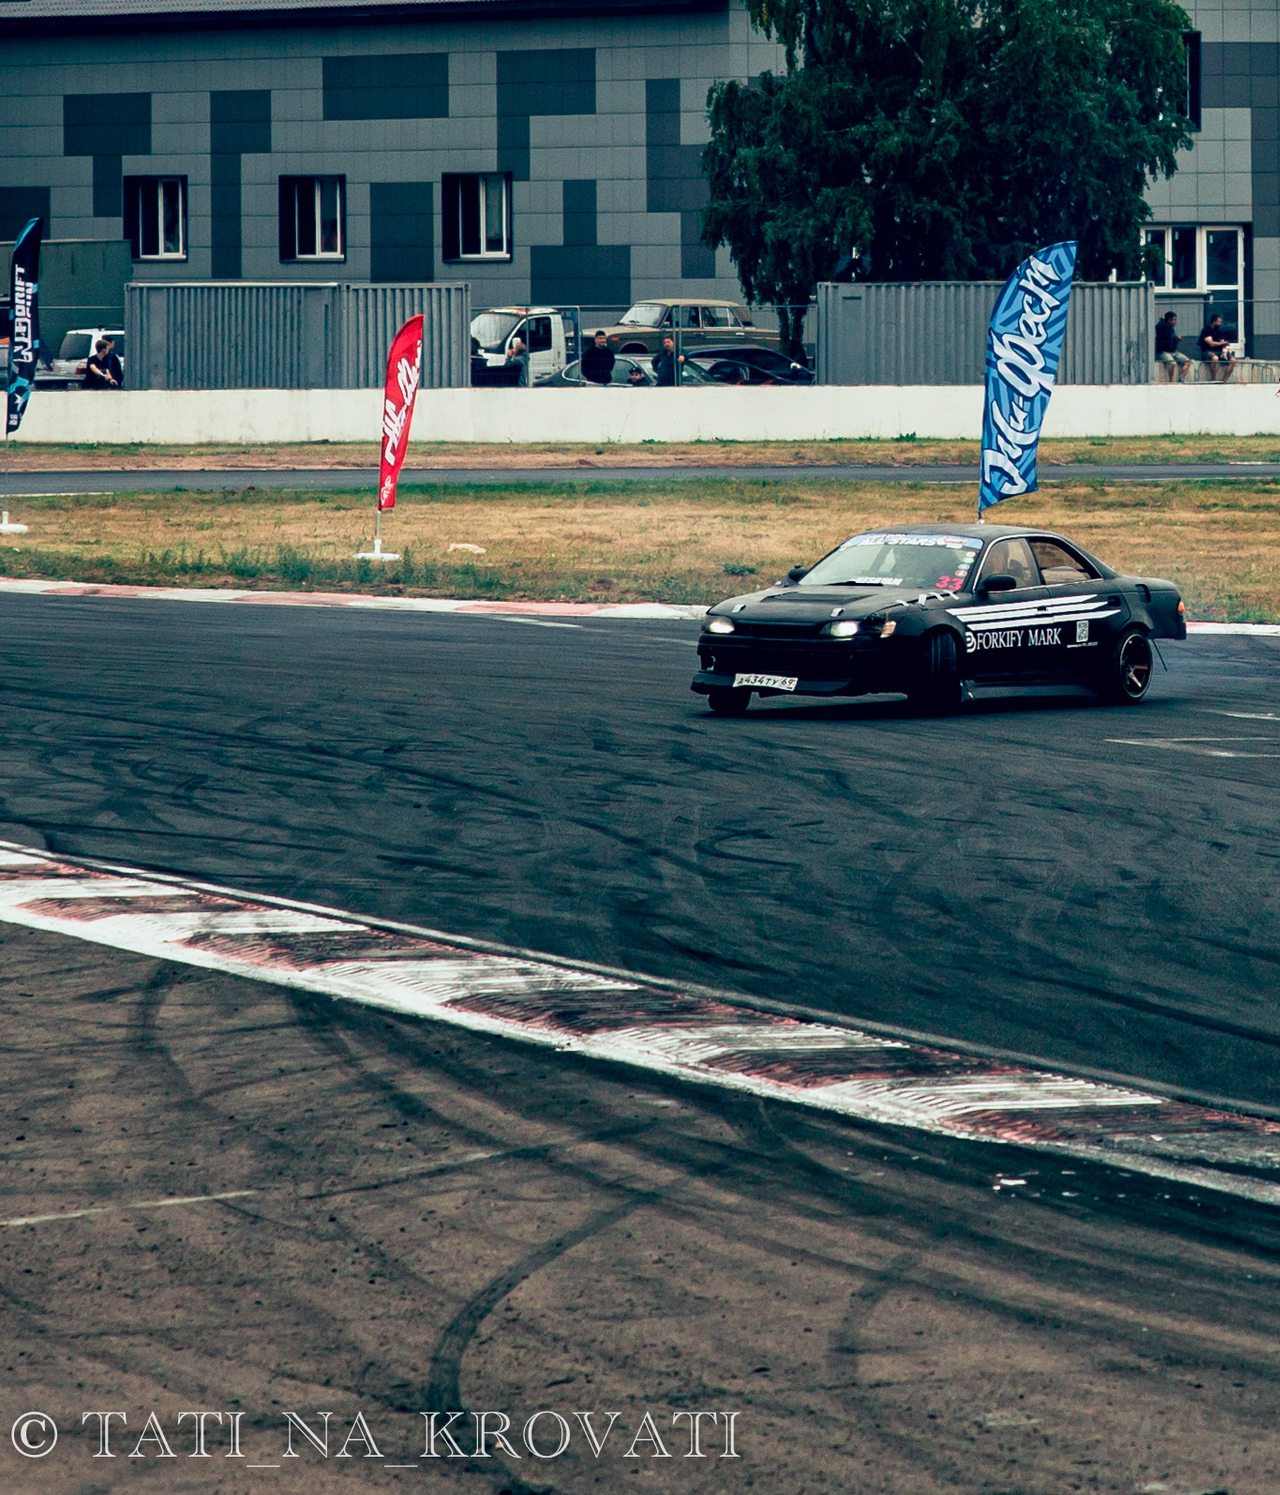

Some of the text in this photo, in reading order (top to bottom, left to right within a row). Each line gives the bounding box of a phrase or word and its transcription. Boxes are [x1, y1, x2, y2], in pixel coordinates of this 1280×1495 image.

[887, 535, 937, 546] STARS
[935, 575, 964, 591] 33
[976, 630, 1024, 650] FORKIFY
[1028, 628, 1062, 647] MARK
